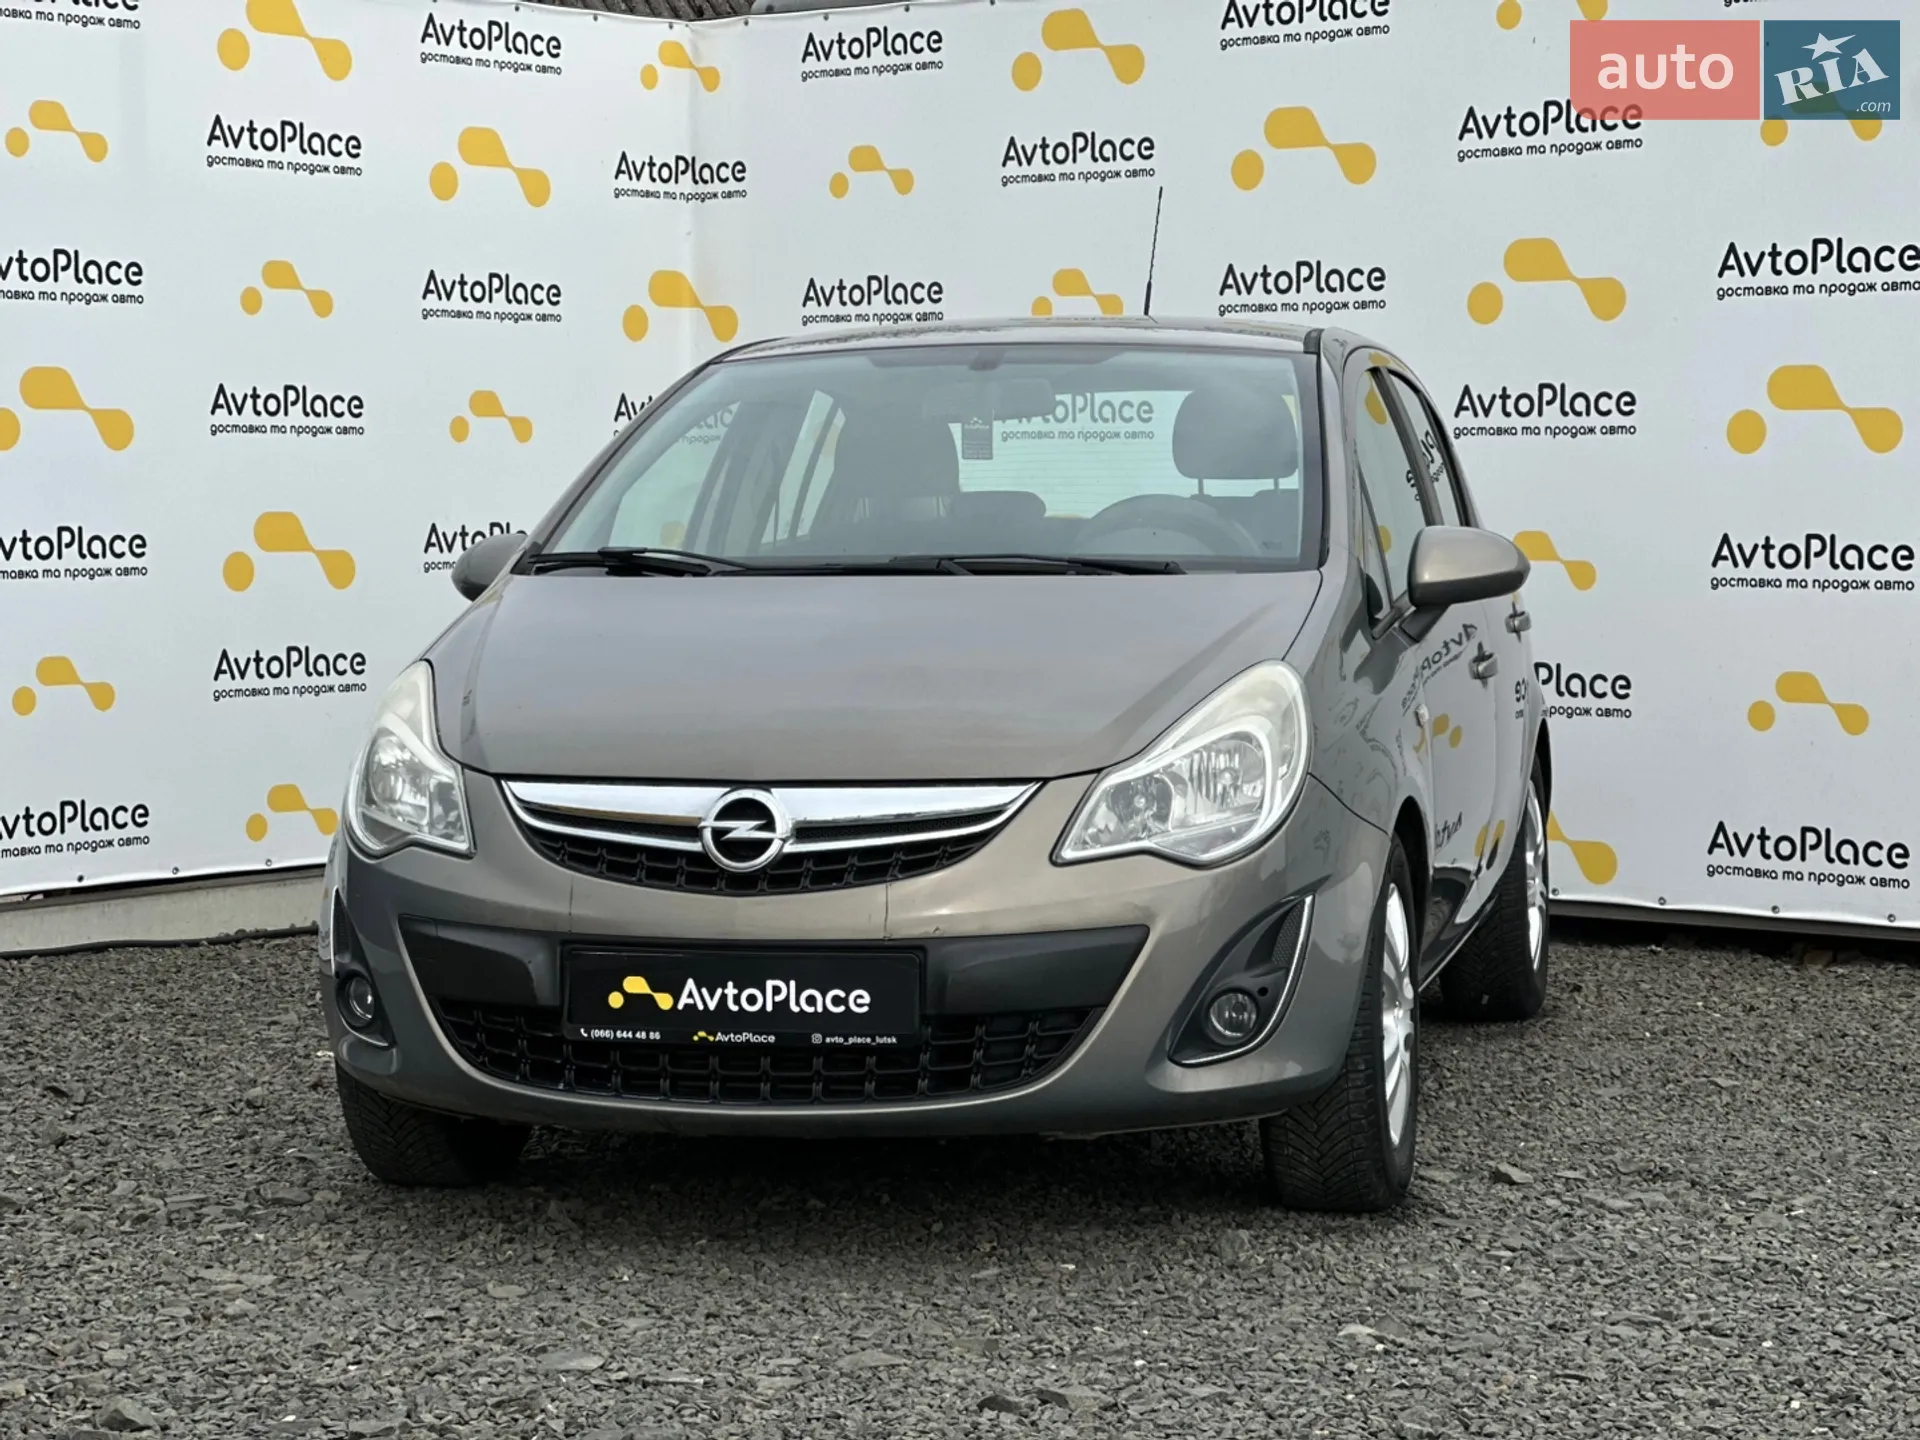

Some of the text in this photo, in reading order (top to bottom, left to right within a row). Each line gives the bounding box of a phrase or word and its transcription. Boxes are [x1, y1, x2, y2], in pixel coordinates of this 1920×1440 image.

[0, 8, 140, 29] авка та продаж авто
[421, 12, 561, 59] AvtoPlace
[801, 25, 943, 63] AvtoPlace
[1220, 24, 1390, 51] доставка та продаж авто
[420, 52, 562, 75] доставка та продаж авто
[801, 60, 943, 82] доставка та продаж авто
[1458, 99, 1643, 141] AvtoPlace
[207, 114, 362, 159] AvtoPlace
[1001, 131, 1155, 168] AvtoPlace
[1457, 138, 1643, 163] доставка та продаж авто
[206, 155, 362, 176] доставка та продаж авто
[614, 151, 746, 185] AvtoPlace
[1001, 168, 1155, 187] доставка та продаж авто
[614, 187, 747, 203] доставка та продаж авто
[1717, 237, 1920, 278] AvtoPlace
[422, 269, 561, 306] AvtoPlace
[1219, 260, 1386, 296] AvtoPlace
[38, 291, 57, 301] та
[60, 292, 108, 305] продаж
[111, 294, 144, 304] авто
[802, 274, 943, 308] AvtoPlace
[1716, 285, 1789, 301] доставка
[1793, 284, 1815, 295] та
[1819, 282, 1877, 297] продаж
[422, 308, 562, 324] доставка та продаж авто
[801, 311, 944, 325] доставка та продаж авто
[1218, 299, 1386, 317] доставка та продаж авто
[210, 383, 364, 419] AvtoPlace
[1454, 382, 1637, 418] AvtoPlace
[210, 424, 365, 437] доставка та продаж авто
[1453, 425, 1637, 440] доставка та продаж авто
[1711, 532, 1915, 572] AvtoPlace
[42, 568, 61, 578] та
[64, 567, 112, 581] продаж
[115, 566, 148, 577] авто
[1710, 577, 1915, 593] доставка та продаж авто
[213, 645, 366, 682] AvtoPlace
[213, 683, 367, 702] доставка та продаж авто
[1596, 706, 1632, 718] авто
[0, 799, 150, 840] vtoPlace
[45, 843, 64, 854] та
[66, 838, 115, 854] продаж
[117, 835, 150, 847] авто
[1707, 820, 1910, 870] AvtoPlace
[1706, 864, 1910, 889] доставка та продаж авто
[677, 977, 871, 1013] AvtoPlace
[616, 1030, 633, 1039] 644
[635, 1031, 646, 1039] 48
[715, 1032, 776, 1043] AvtoPlace
[825, 1035, 897, 1046] avto_place_lutsk
